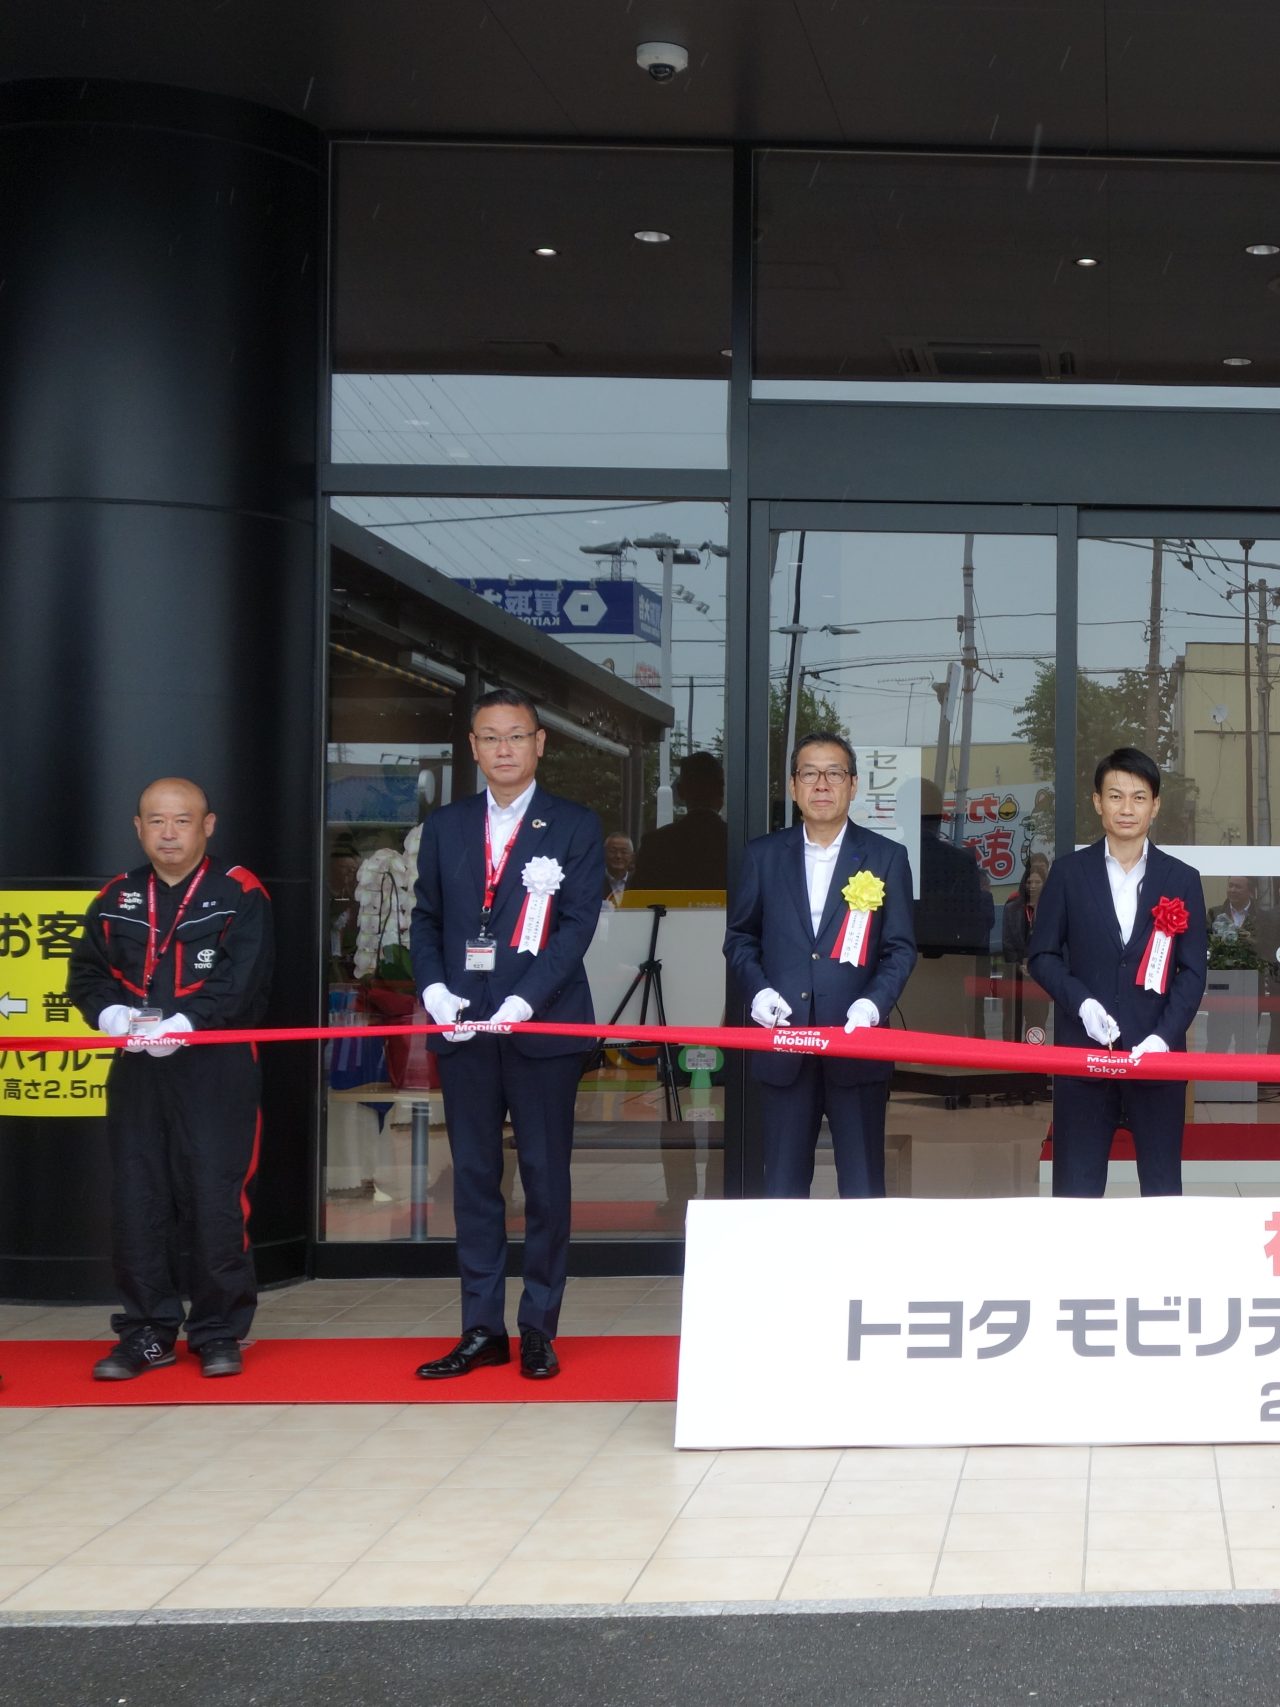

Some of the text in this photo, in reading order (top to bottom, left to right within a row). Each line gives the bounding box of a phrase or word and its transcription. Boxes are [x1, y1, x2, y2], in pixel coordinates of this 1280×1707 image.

[773, 1035, 830, 1050] Mobility
[1087, 1056, 1141, 1066] Mobility
[1087, 1065, 1127, 1075] Tokyo
[846, 1299, 1031, 1361] トヨタ
